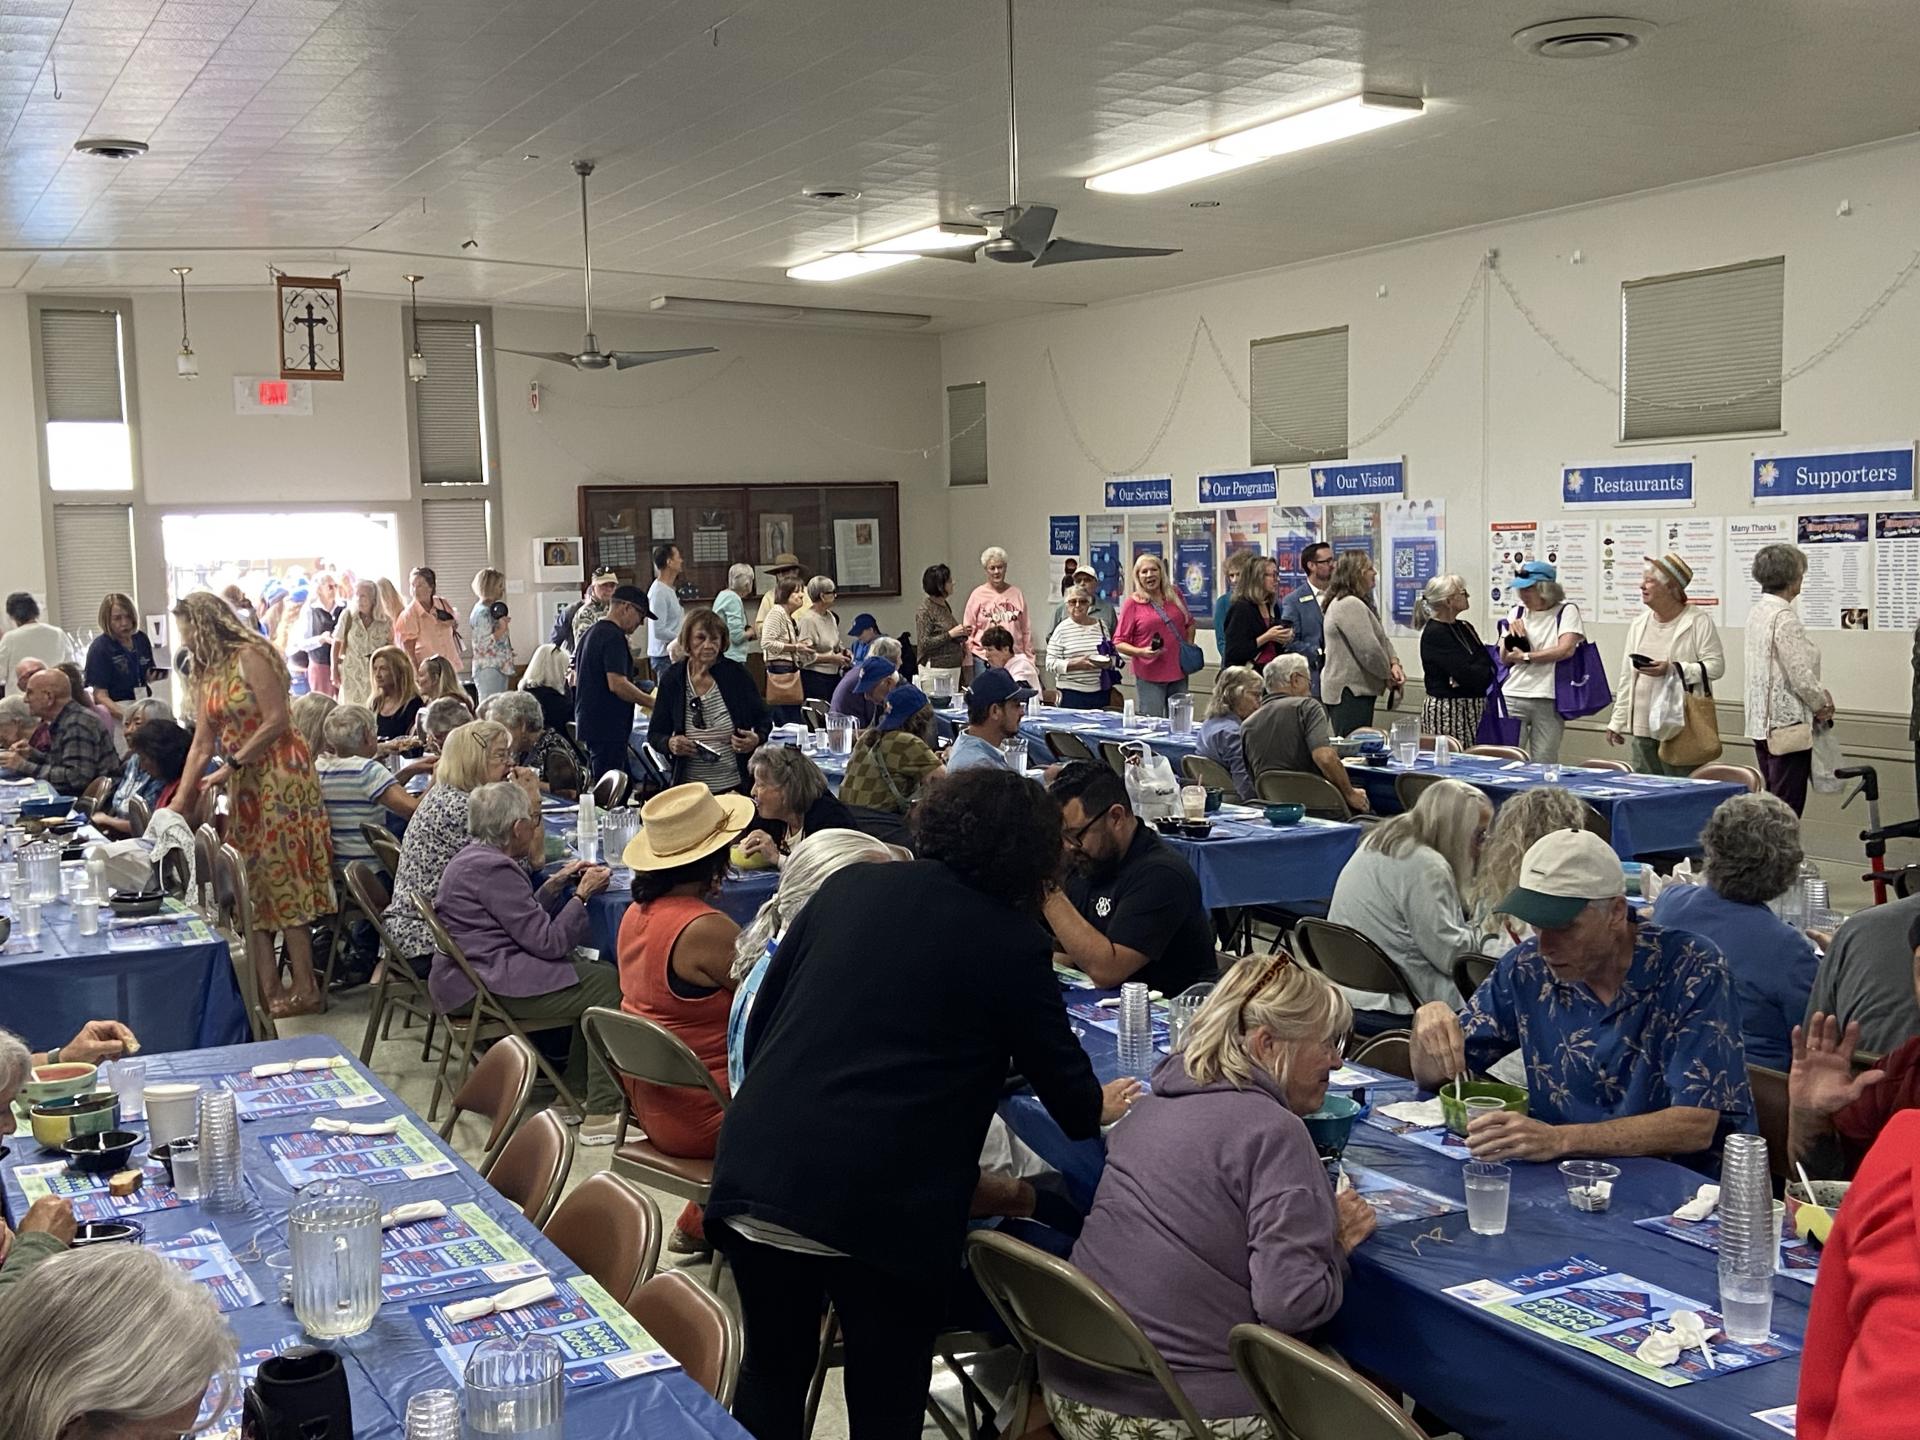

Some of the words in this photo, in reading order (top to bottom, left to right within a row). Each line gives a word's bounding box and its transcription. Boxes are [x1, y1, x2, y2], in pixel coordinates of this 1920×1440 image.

[1336, 474, 1358, 489] Our
[1360, 471, 1395, 488] Vision
[1593, 474, 1684, 493] Restaurants
[1796, 465, 1897, 489] Supporters
[1119, 487, 1134, 501] Our
[1135, 486, 1168, 501] Services
[1213, 482, 1231, 497] Our
[1232, 481, 1275, 497] Programs
[1054, 528, 1075, 541] Empty
[1731, 525, 1749, 534] Many
[1751, 523, 1777, 532] Thanks
[1055, 540, 1074, 551] Bowls
